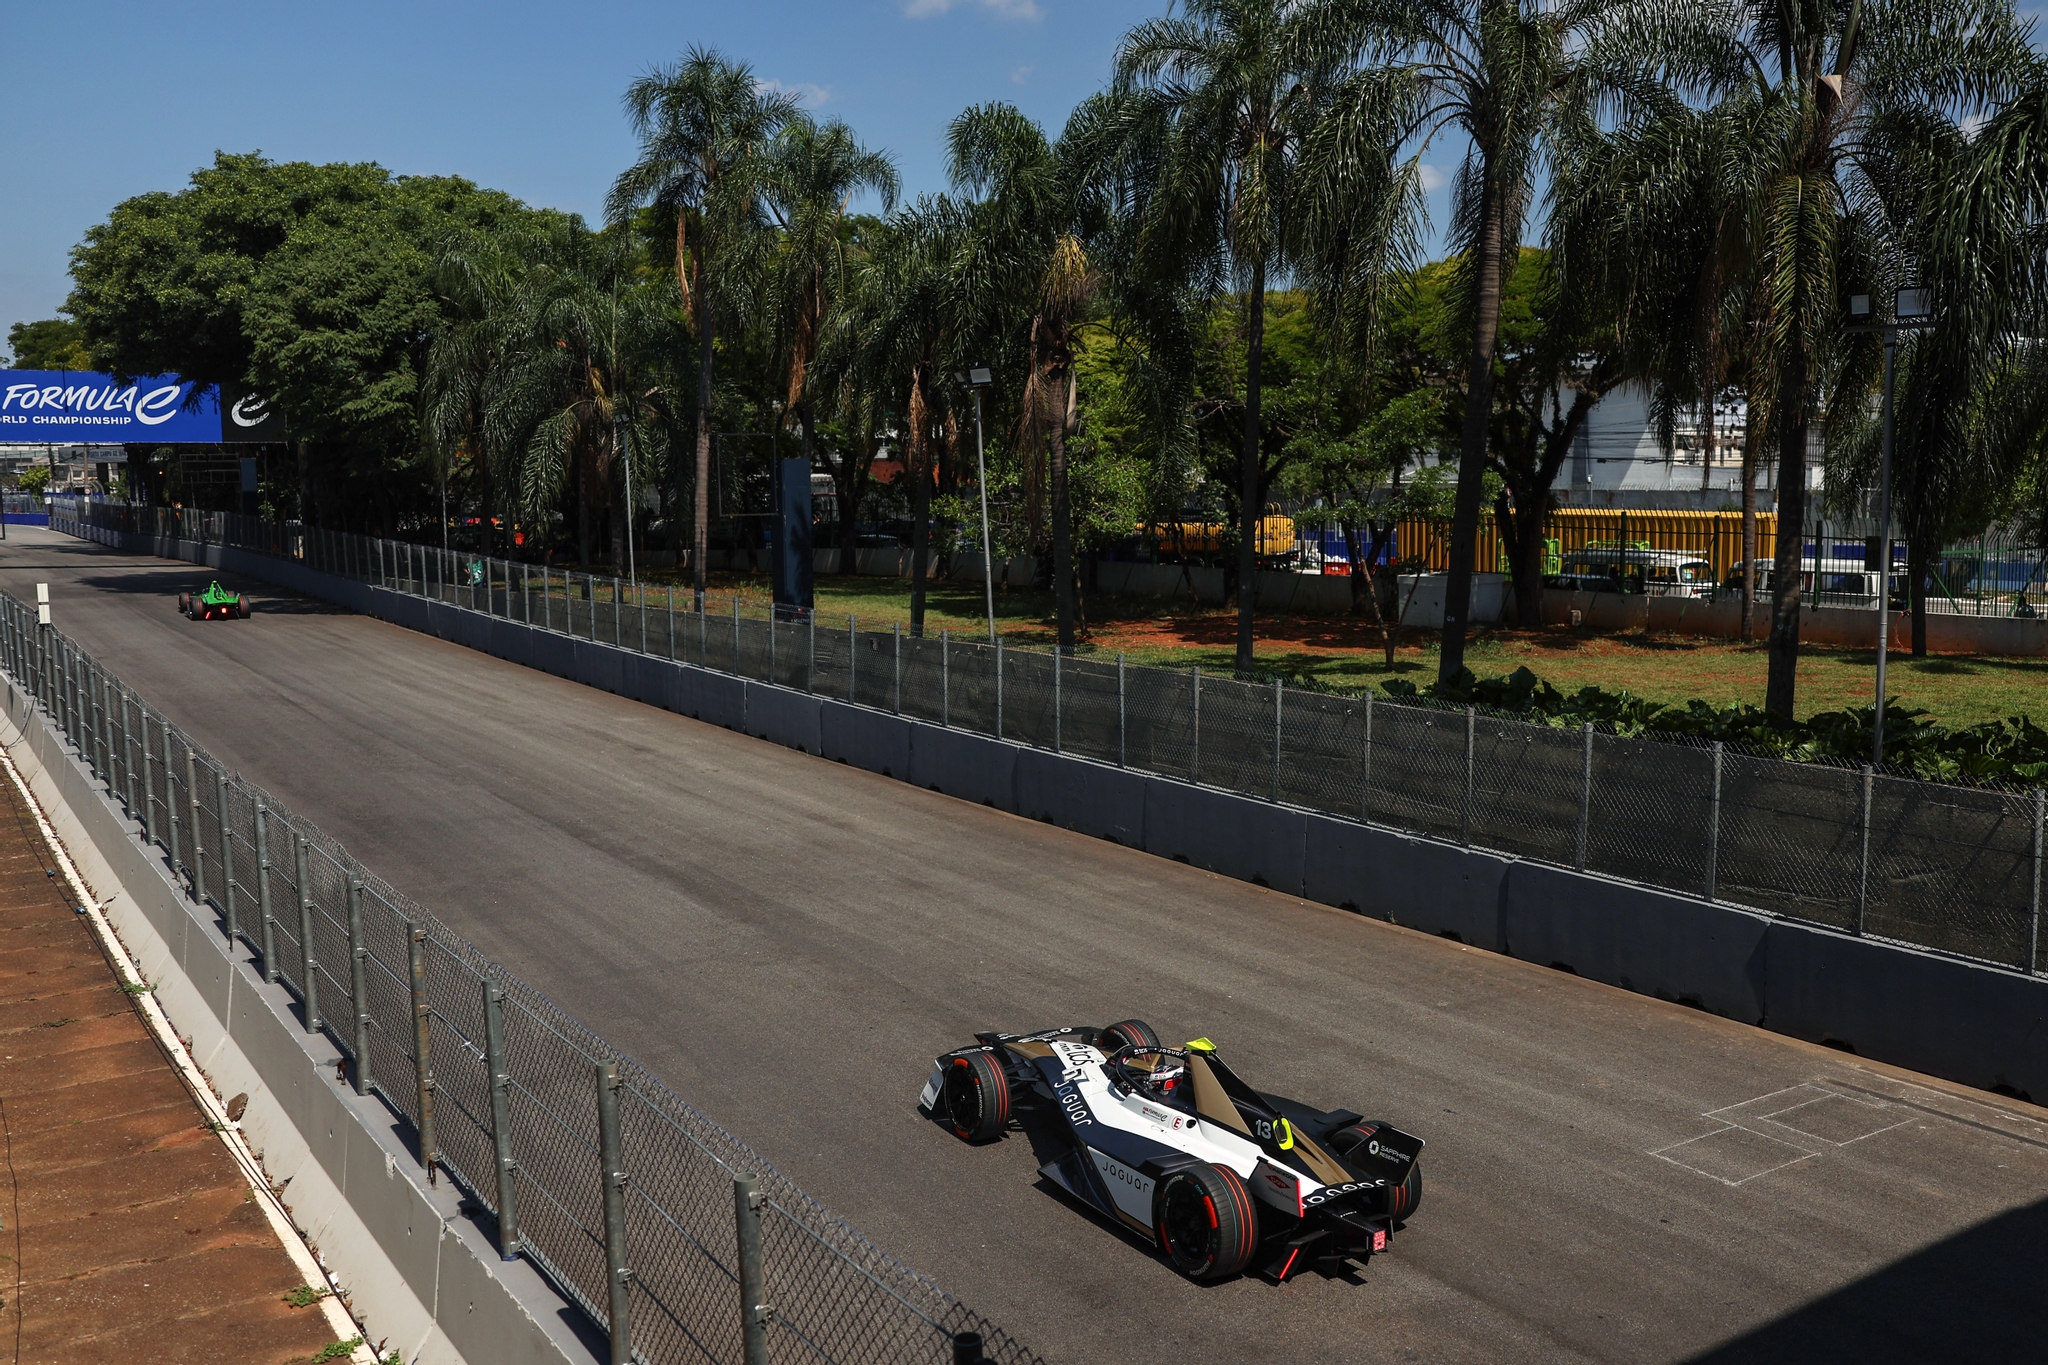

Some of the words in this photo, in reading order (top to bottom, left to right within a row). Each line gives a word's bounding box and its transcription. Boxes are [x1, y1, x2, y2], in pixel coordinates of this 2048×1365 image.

[2, 384, 138, 412] FORMULA
[0, 415, 28, 424] RLD
[32, 416, 132, 425] CHAMPIONSHIP
[1173, 1117, 1183, 1129] E
[1255, 1119, 1272, 1140] 13
[1379, 1151, 1400, 1164] RESERVE
[1380, 1145, 1411, 1163] SAPPHIRE
